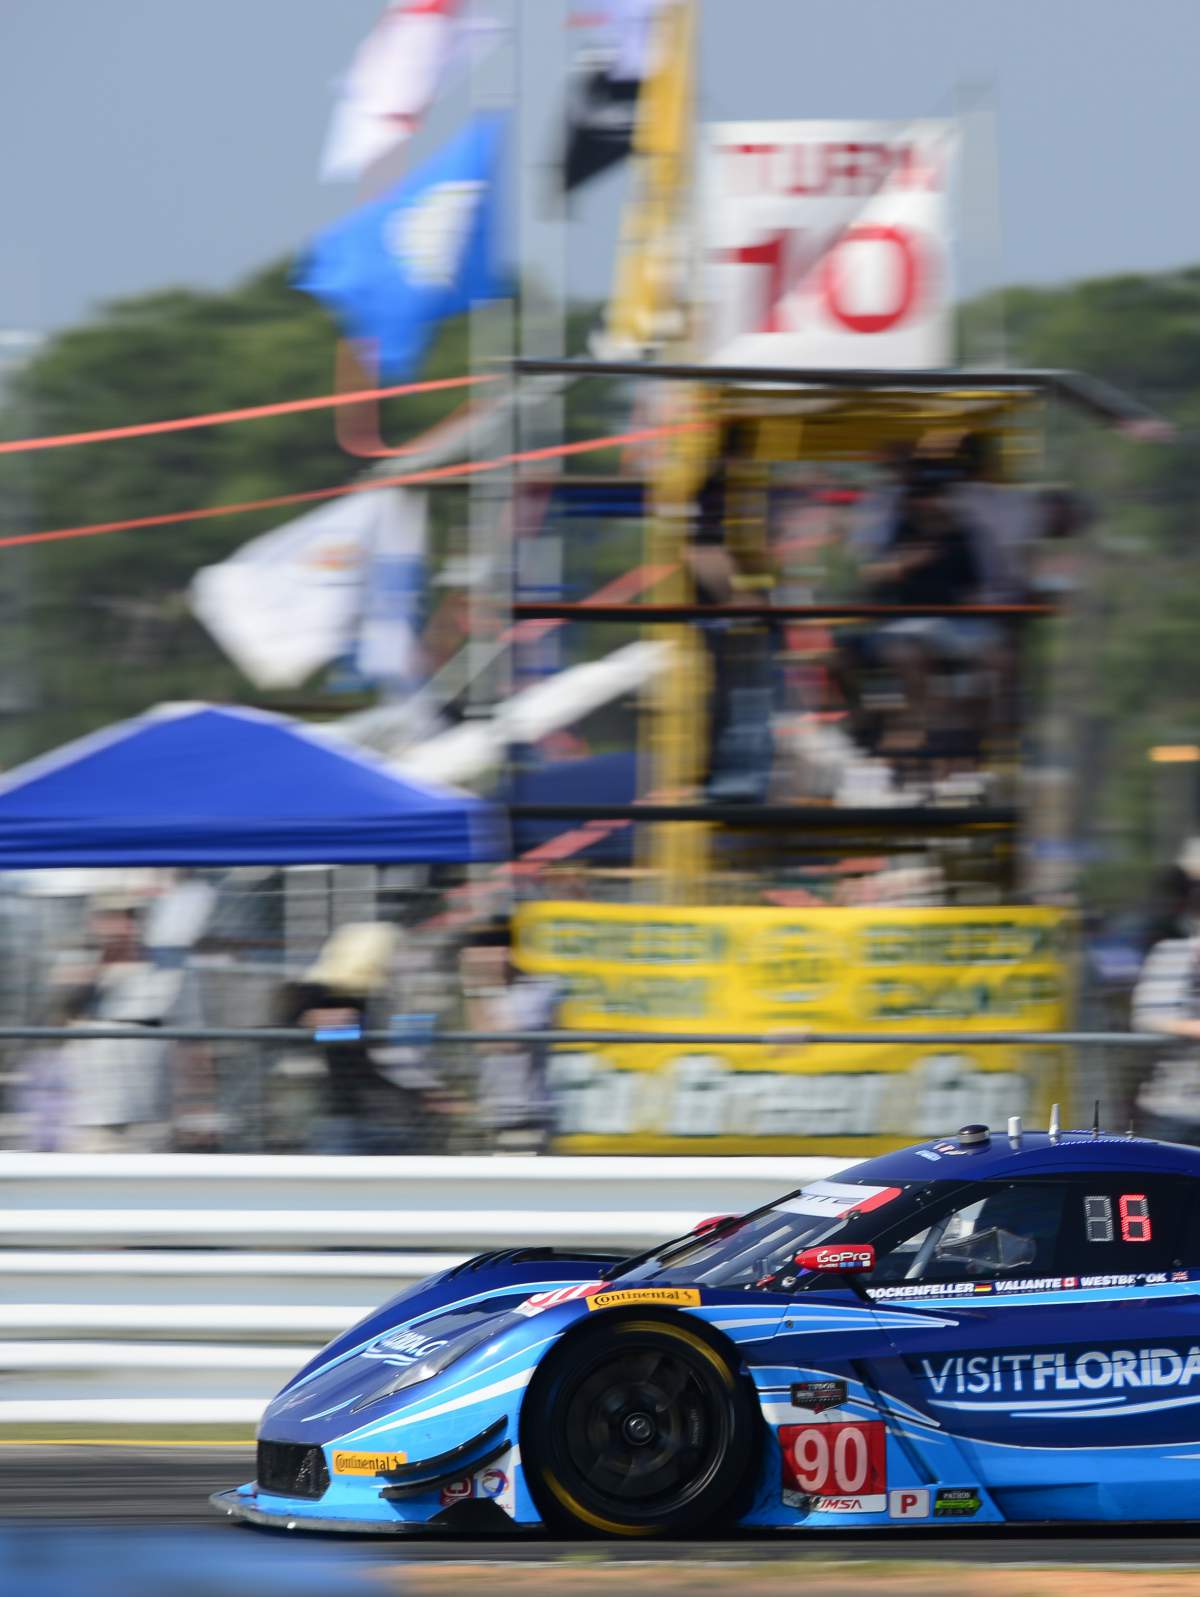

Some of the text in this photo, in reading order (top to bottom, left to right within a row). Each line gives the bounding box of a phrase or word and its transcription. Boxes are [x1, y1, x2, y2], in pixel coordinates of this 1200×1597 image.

[713, 142, 945, 196] TURN
[706, 228, 945, 333] 10
[817, 1250, 871, 1263] GoPro
[995, 1277, 1061, 1291] VALIANTE
[594, 1289, 679, 1305] Continental
[335, 1453, 390, 1473] Continental
[794, 1427, 868, 1492] 90
[901, 1494, 918, 1514] P
